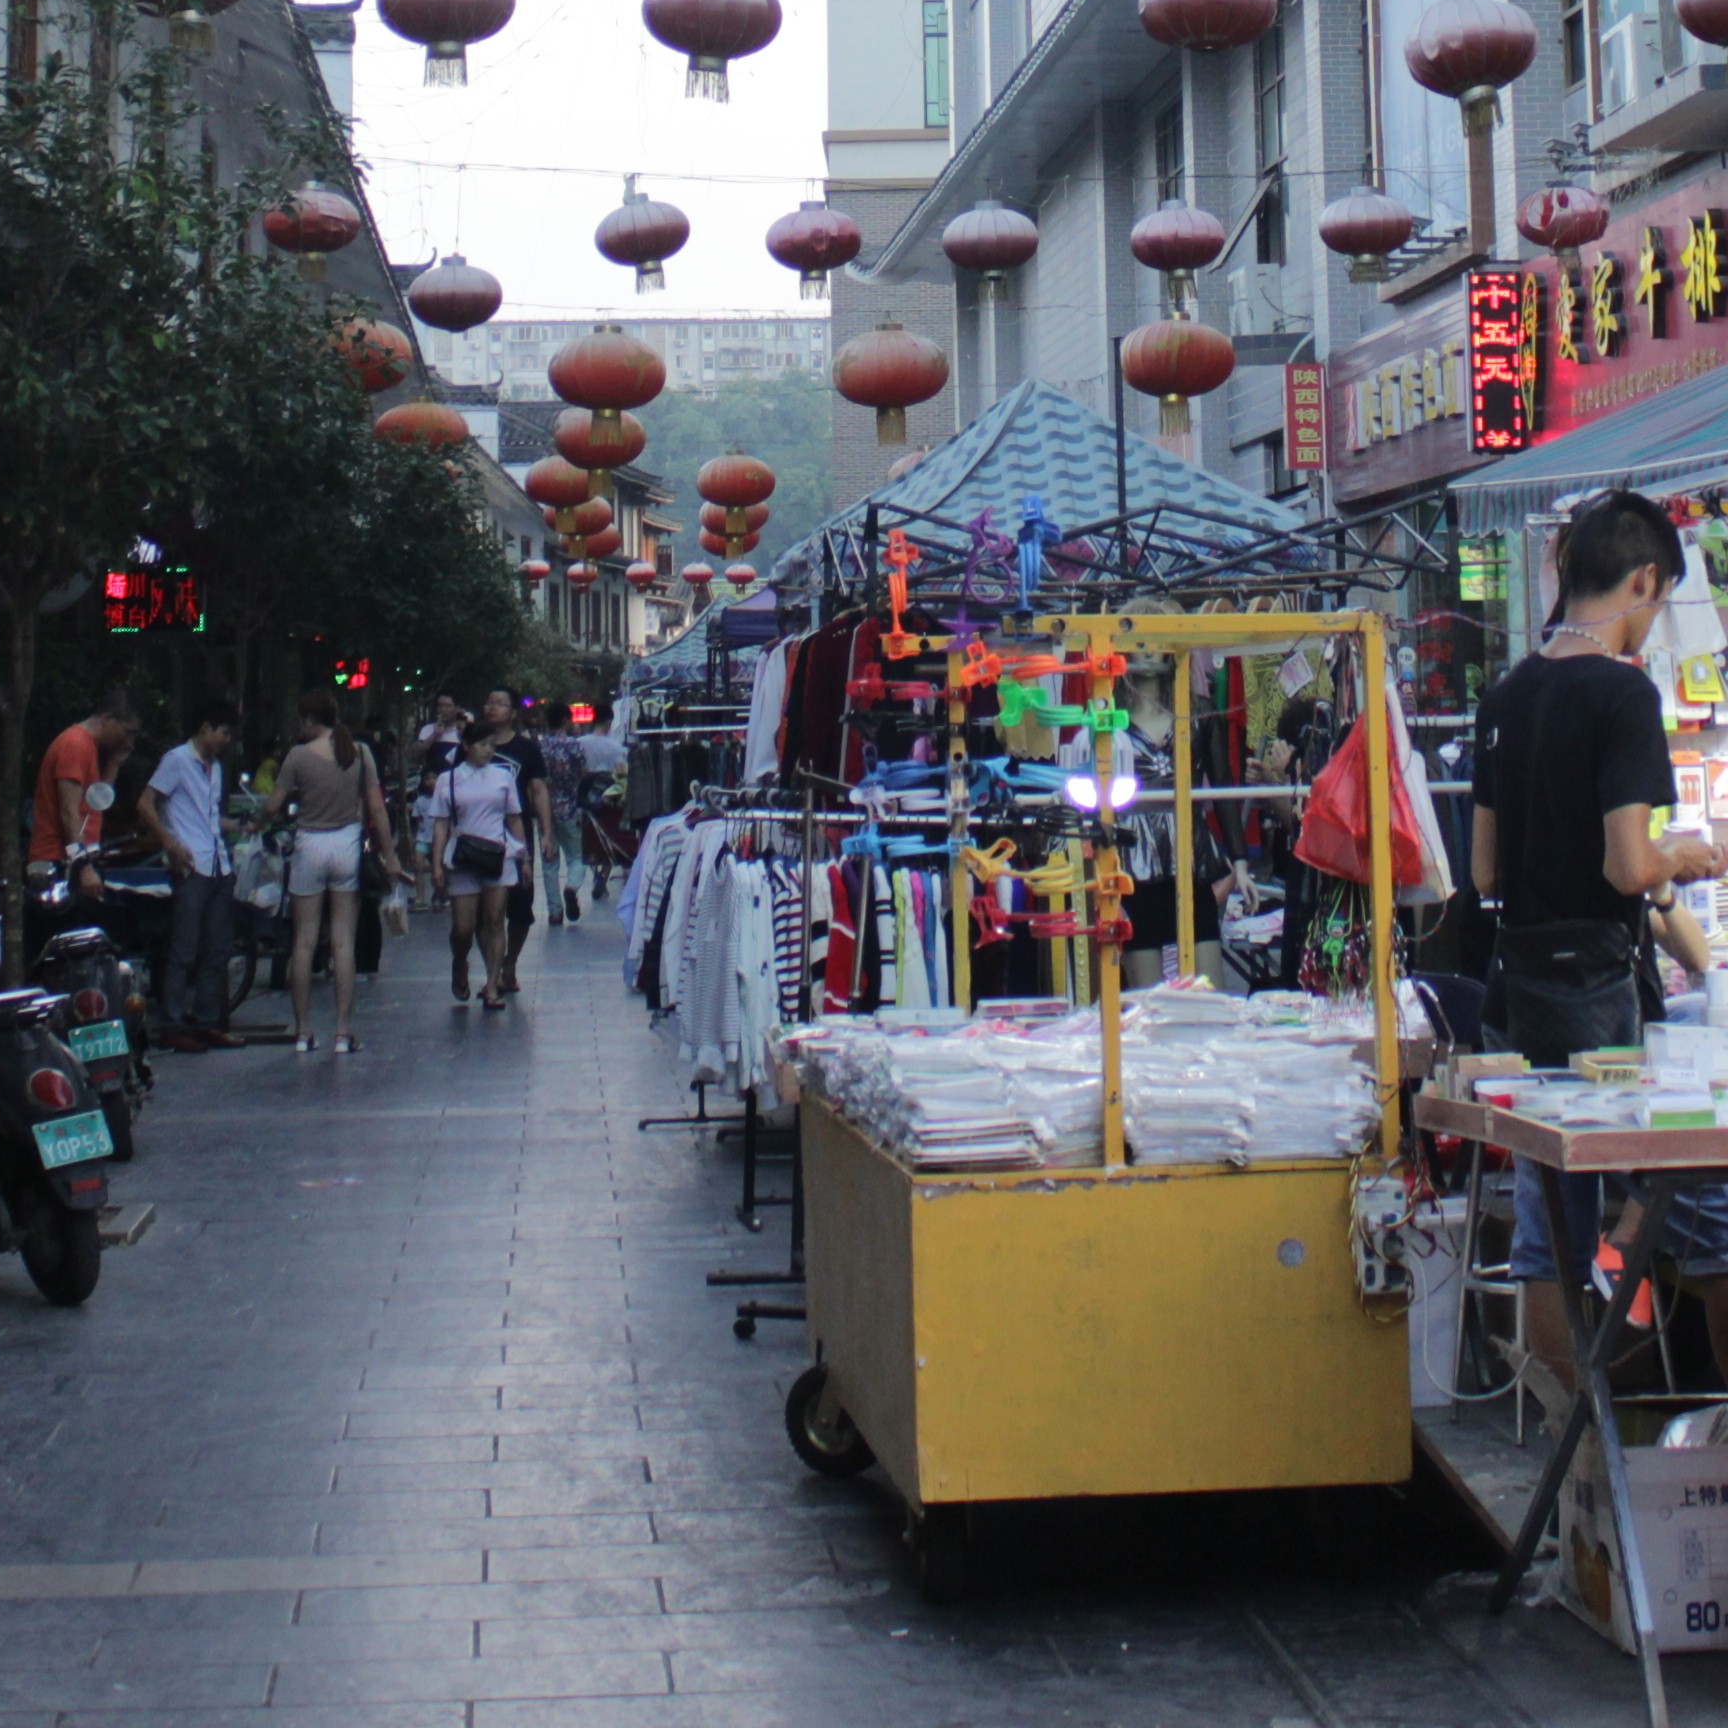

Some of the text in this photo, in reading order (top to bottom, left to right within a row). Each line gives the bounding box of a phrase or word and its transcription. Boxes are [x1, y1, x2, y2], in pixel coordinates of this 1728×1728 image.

[1293, 368, 1321, 463] 陕西特色面
[1685, 1601, 1720, 1633] 80
